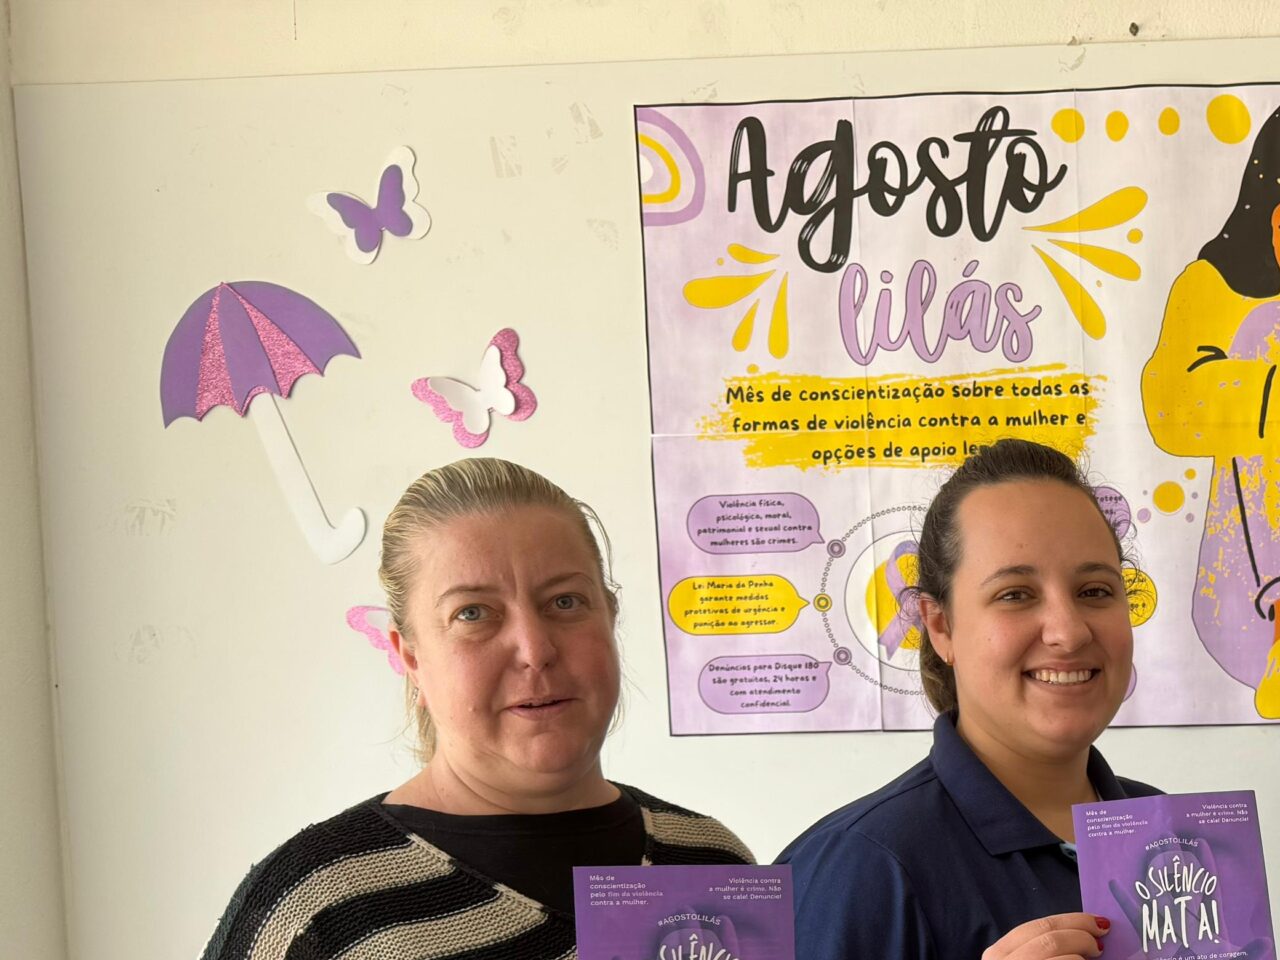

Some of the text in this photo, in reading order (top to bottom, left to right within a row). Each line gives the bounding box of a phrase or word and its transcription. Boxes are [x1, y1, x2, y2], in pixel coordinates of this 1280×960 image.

[727, 105, 1068, 273] Agosto
[838, 259, 1042, 366] lilás
[726, 380, 1090, 404] Mês de conscientização sobre todas as
[732, 410, 1086, 432] formas de violência contra a mulher e
[812, 445, 876, 465] opções
[883, 442, 903, 457] de
[910, 442, 956, 462] apoio
[719, 499, 784, 508] Violência física,
[716, 513, 763, 524] psicológica,
[697, 526, 746, 536] patrimonial
[755, 525, 781, 533] sexual
[783, 524, 812, 532] contra
[710, 538, 749, 547] mulheres
[692, 582, 704, 590] Lei
[707, 581, 733, 589] Maria
[748, 580, 774, 588] Penha
[699, 595, 733, 604] garante
[684, 608, 729, 618] protetivas
[743, 605, 778, 615] urgência
[693, 620, 725, 629] punição
[709, 661, 819, 673] Denúncias para Disque 180
[729, 676, 771, 686] gratuitas,
[749, 687, 801, 695] atendimento
[1145, 837, 1198, 850] #AGOSTOLILÁS
[1135, 855, 1216, 899] O SILÊNCIO
[658, 913, 720, 926] #AGOSTOLILÁS
[1142, 895, 1219, 952] MATA!
